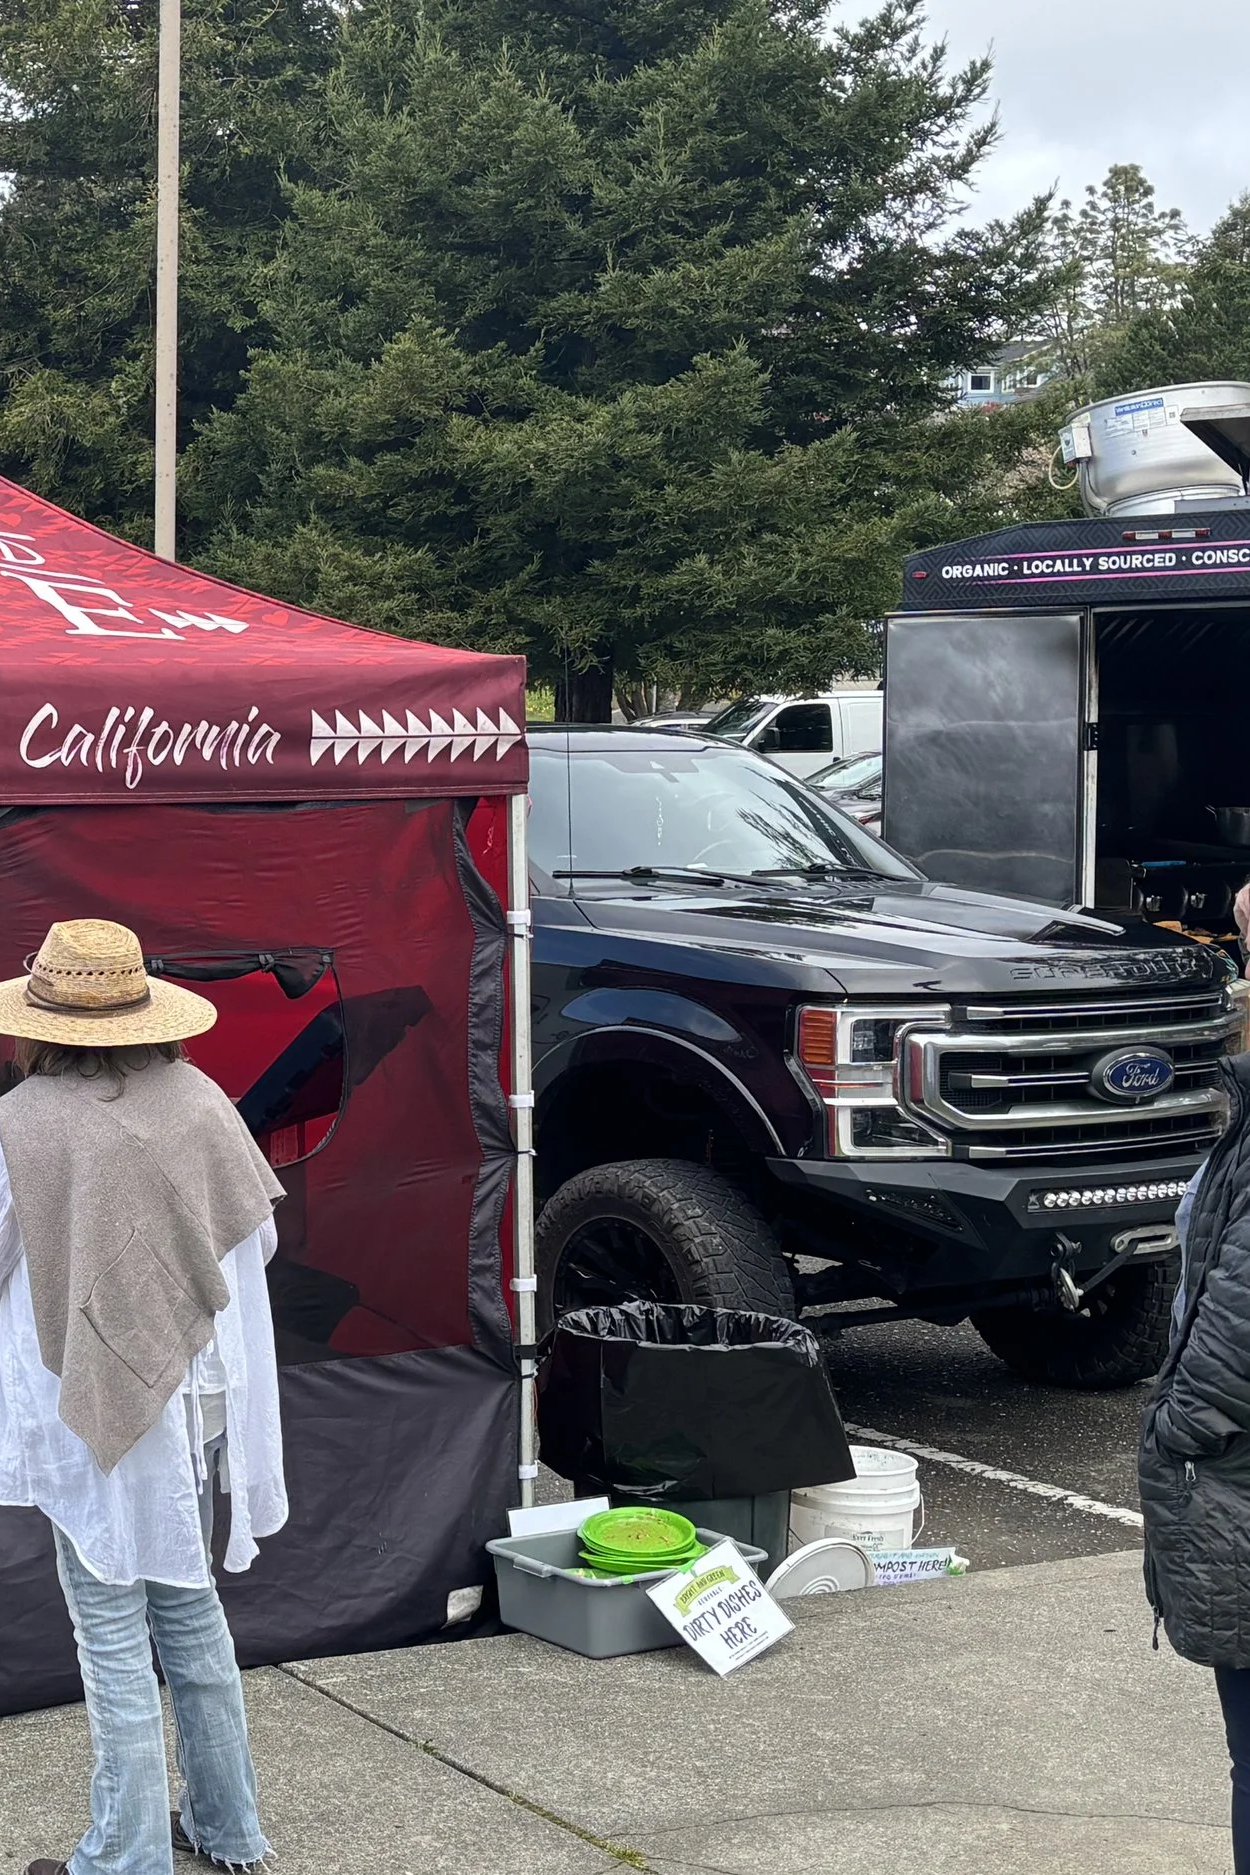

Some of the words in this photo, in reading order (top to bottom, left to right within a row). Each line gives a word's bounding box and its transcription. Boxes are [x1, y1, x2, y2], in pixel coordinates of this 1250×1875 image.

[941, 562, 1009, 579] ORGANIC
[1022, 557, 1094, 575] LOCALLY
[1098, 552, 1176, 571] SOURCED
[19, 702, 282, 789] California
[1121, 1062, 1160, 1088] Ford
[874, 1561, 917, 1574] MPOST
[682, 1606, 722, 1642] DIRTY
[718, 1579, 762, 1619] DISHES
[719, 1616, 758, 1650] HERE
